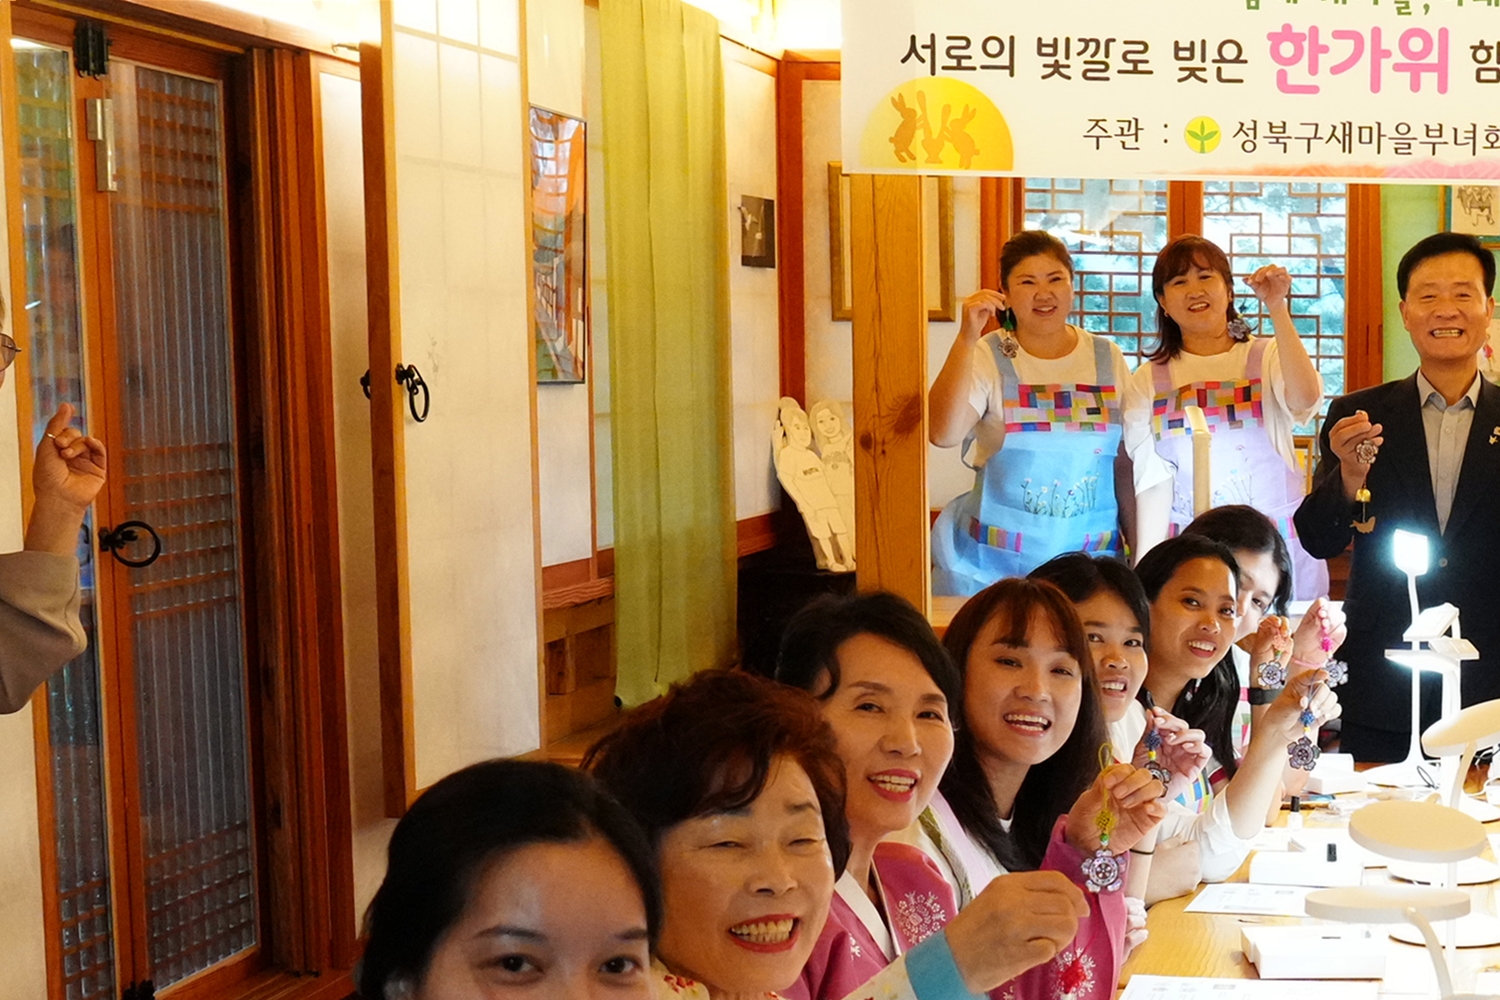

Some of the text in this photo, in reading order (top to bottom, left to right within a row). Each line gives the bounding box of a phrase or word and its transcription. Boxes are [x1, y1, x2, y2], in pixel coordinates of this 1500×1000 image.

[899, 33, 1016, 79] 서로의
[1036, 36, 1155, 82] 빛깔로
[1173, 38, 1249, 84] 빚은
[1266, 23, 1449, 95] 한가위
[1082, 116, 1145, 151] 주관
